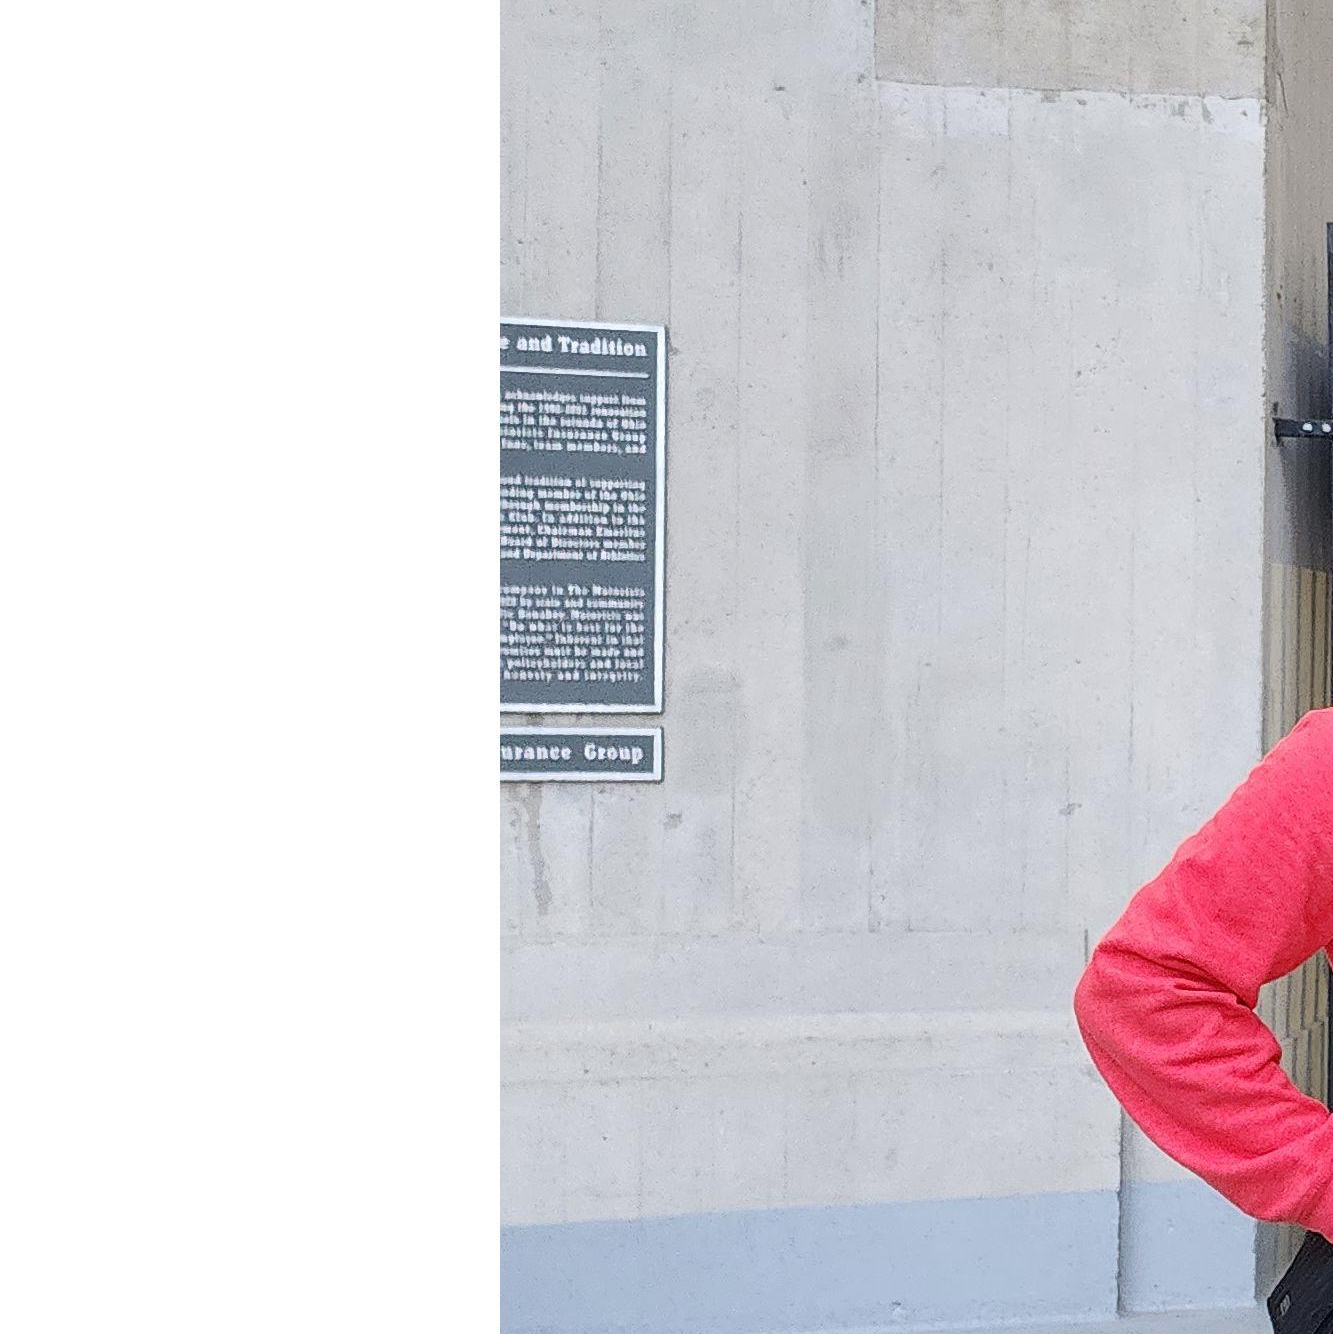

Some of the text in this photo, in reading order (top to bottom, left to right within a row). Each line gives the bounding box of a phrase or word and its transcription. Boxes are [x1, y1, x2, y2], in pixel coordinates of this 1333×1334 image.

[516, 334, 553, 352] and
[557, 335, 648, 357] Tradition
[583, 742, 644, 765] Group
